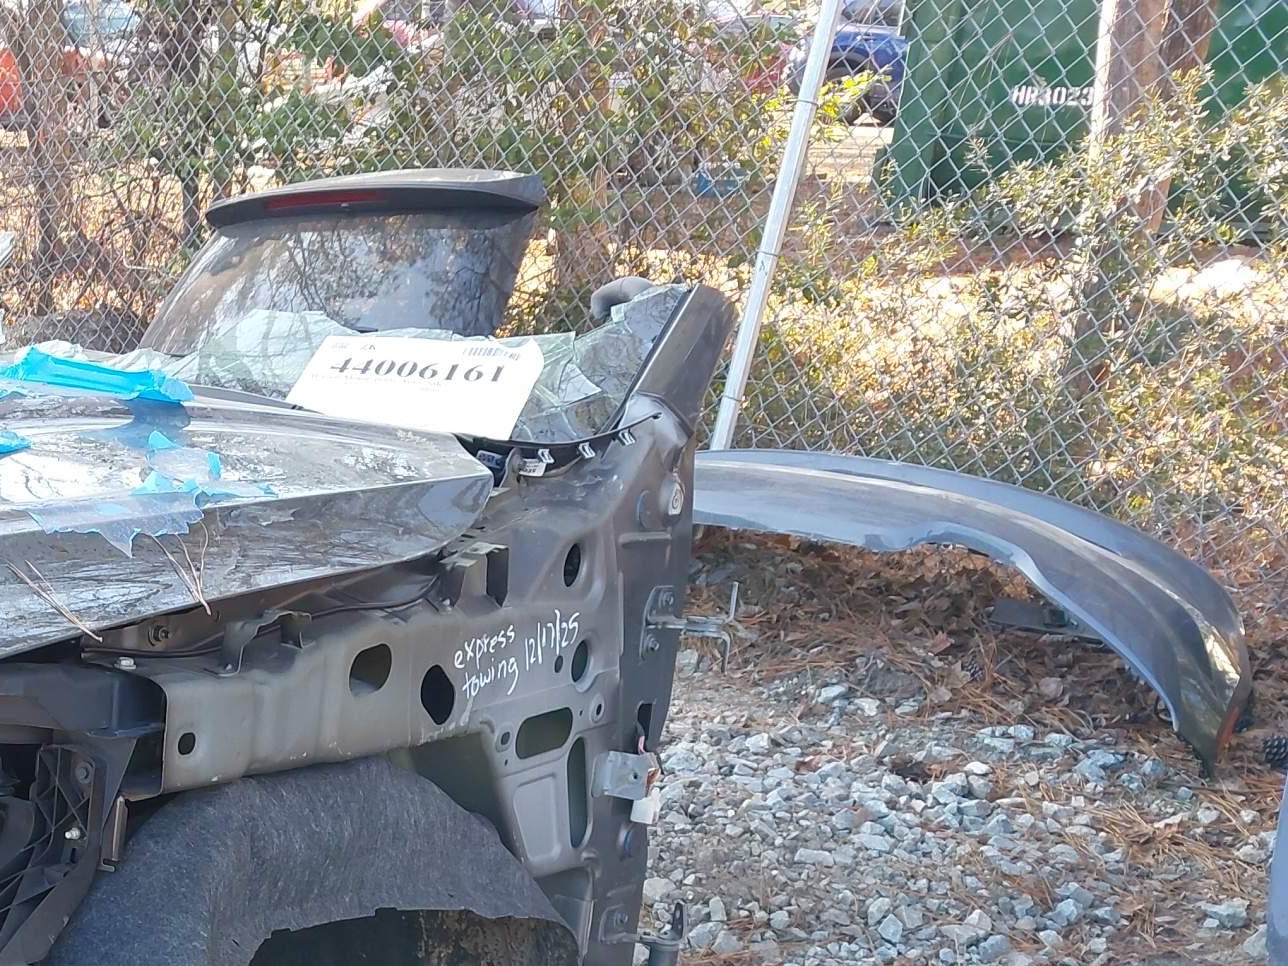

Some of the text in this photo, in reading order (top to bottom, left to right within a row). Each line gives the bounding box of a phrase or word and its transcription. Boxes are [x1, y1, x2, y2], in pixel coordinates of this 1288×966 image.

[329, 356, 505, 383] 44006161
[454, 624, 516, 670] express
[462, 608, 581, 699] towing 12/17/25
